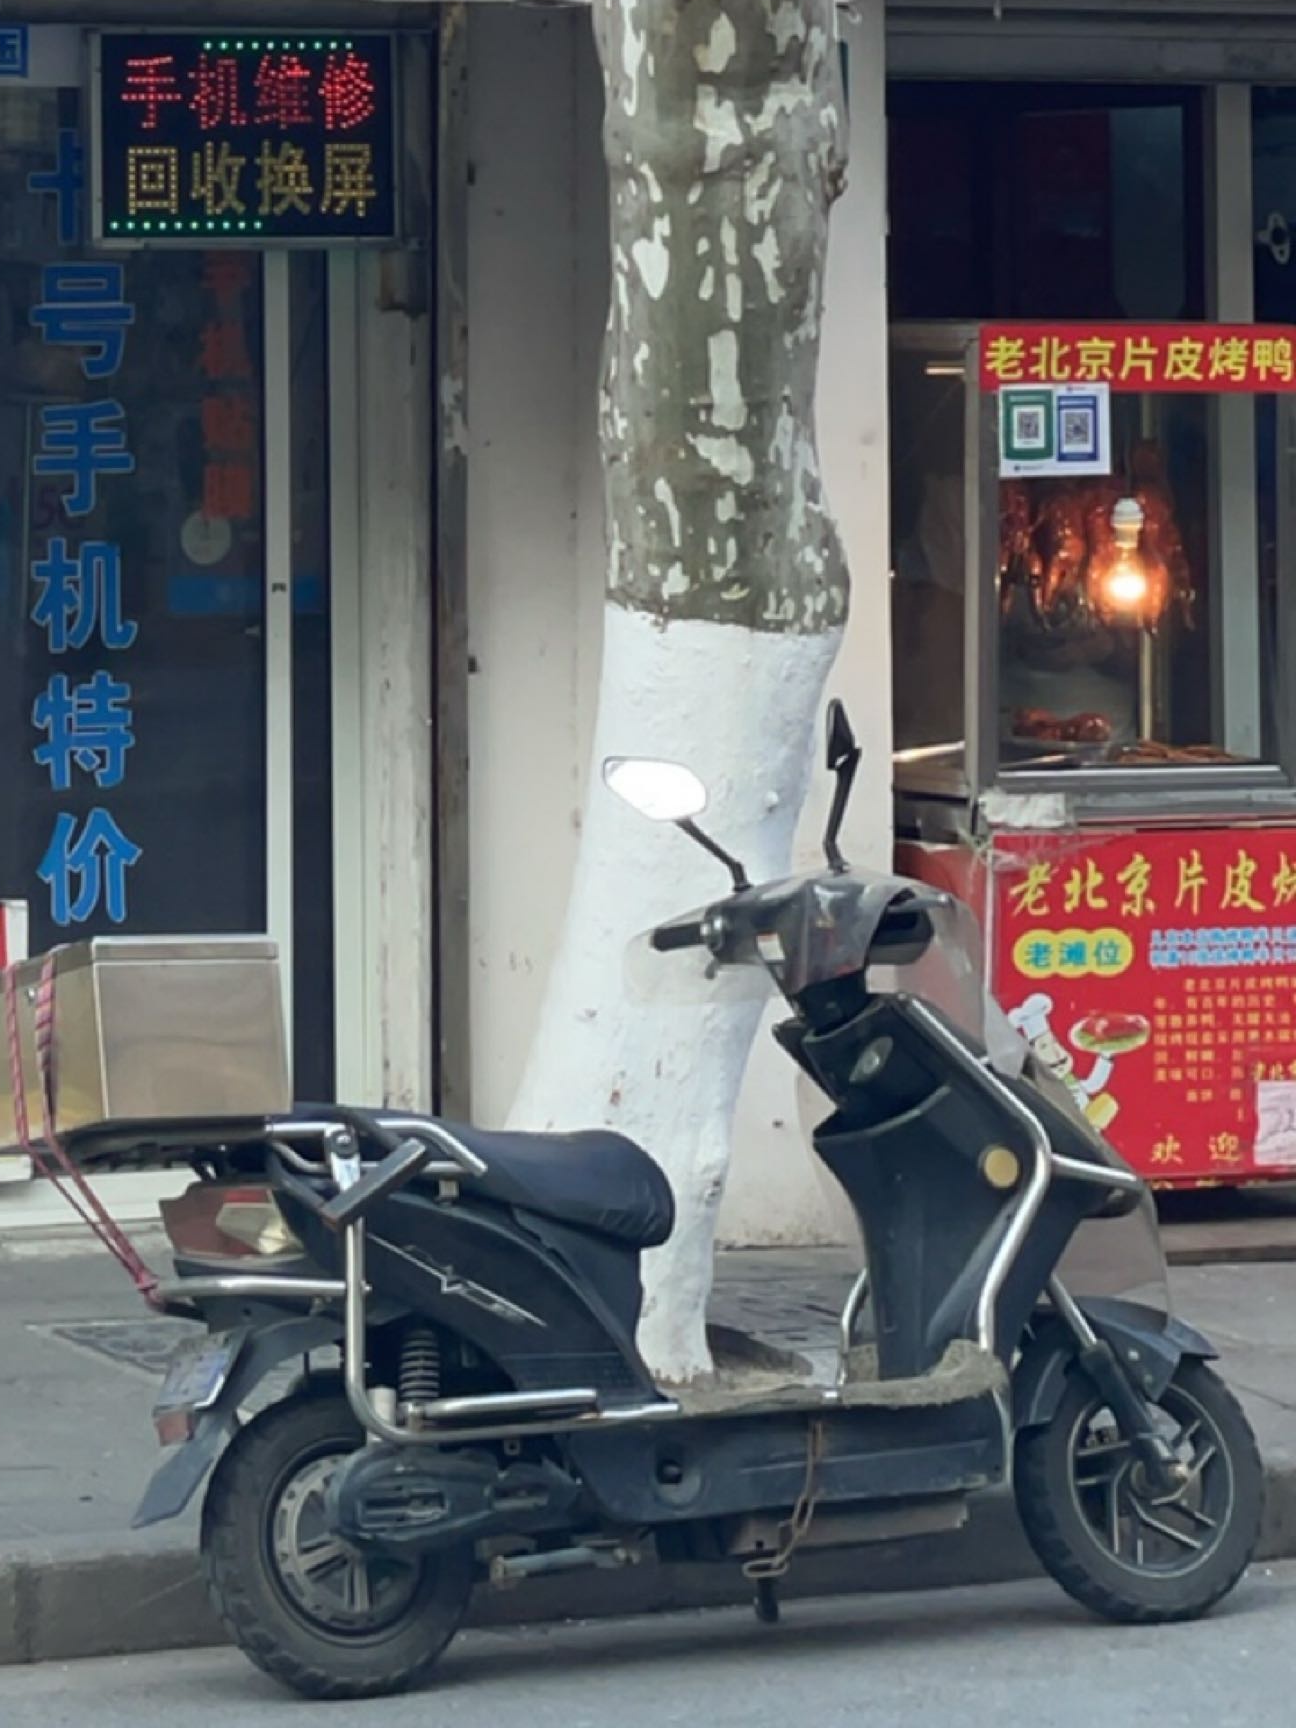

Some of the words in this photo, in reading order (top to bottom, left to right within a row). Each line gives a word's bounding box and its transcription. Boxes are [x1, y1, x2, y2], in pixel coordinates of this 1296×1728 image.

[121, 52, 375, 130] 手机维修
[128, 139, 377, 217] 回收换屏
[985, 336, 1294, 381] 老北京片皮烤鸭
[1150, 1132, 1241, 1164] 欢迎
